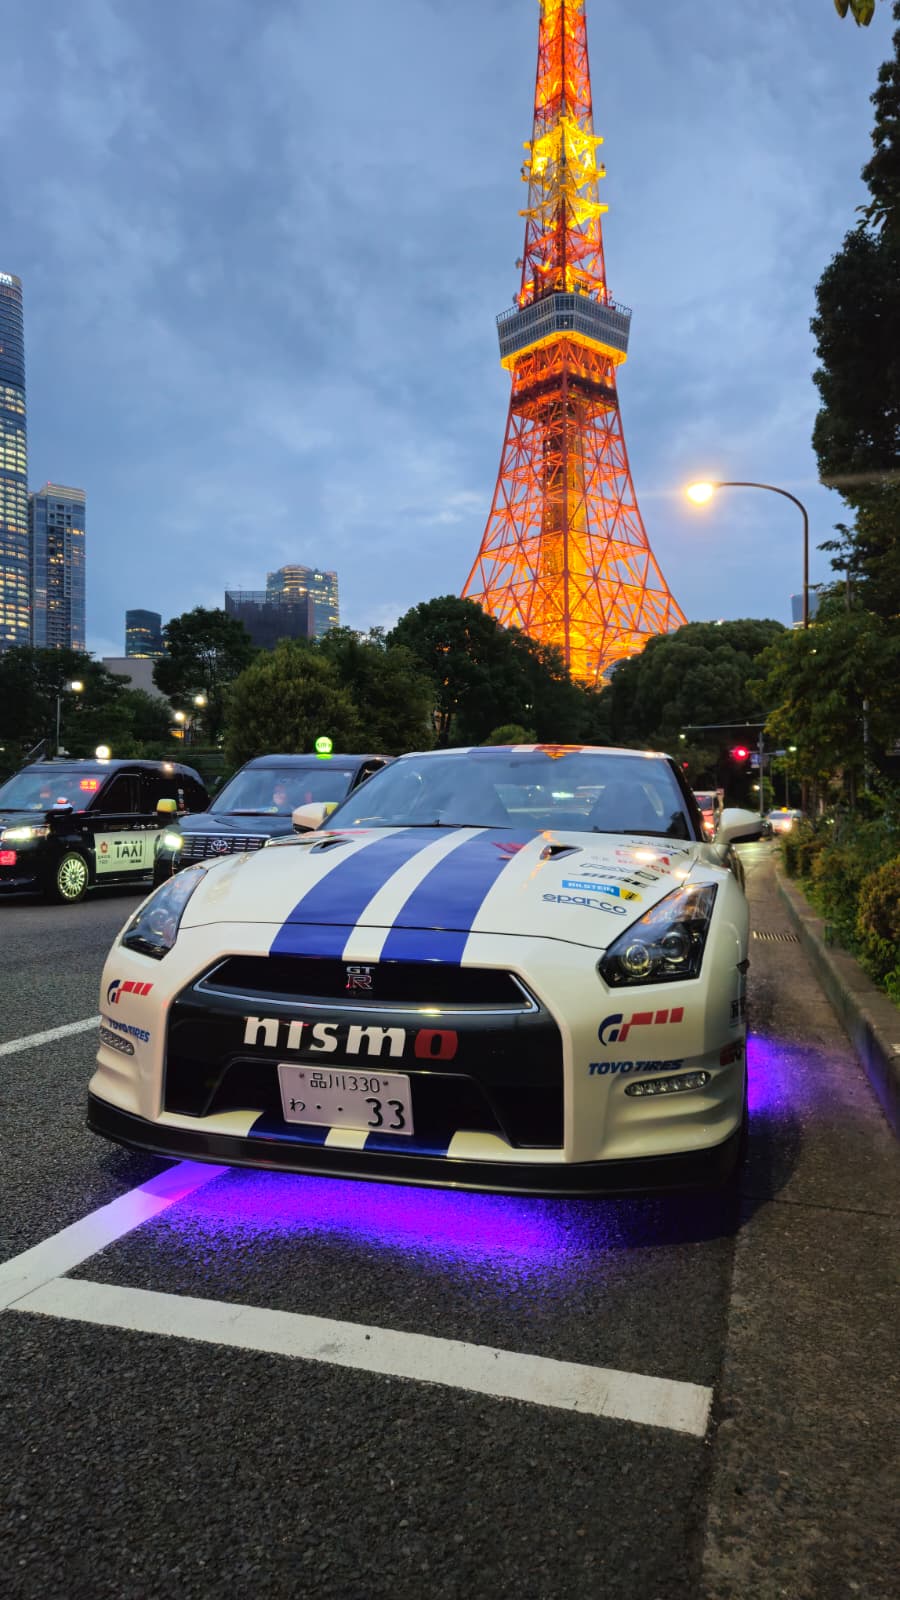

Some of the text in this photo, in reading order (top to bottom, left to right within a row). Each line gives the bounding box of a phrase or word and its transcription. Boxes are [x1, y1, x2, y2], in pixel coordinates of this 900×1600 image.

[114, 840, 143, 858] TAXI
[542, 893, 627, 914] sparco
[243, 1016, 458, 1060] nismo
[588, 1059, 685, 1076] TOYO TIRES
[365, 1098, 405, 1130] 33
